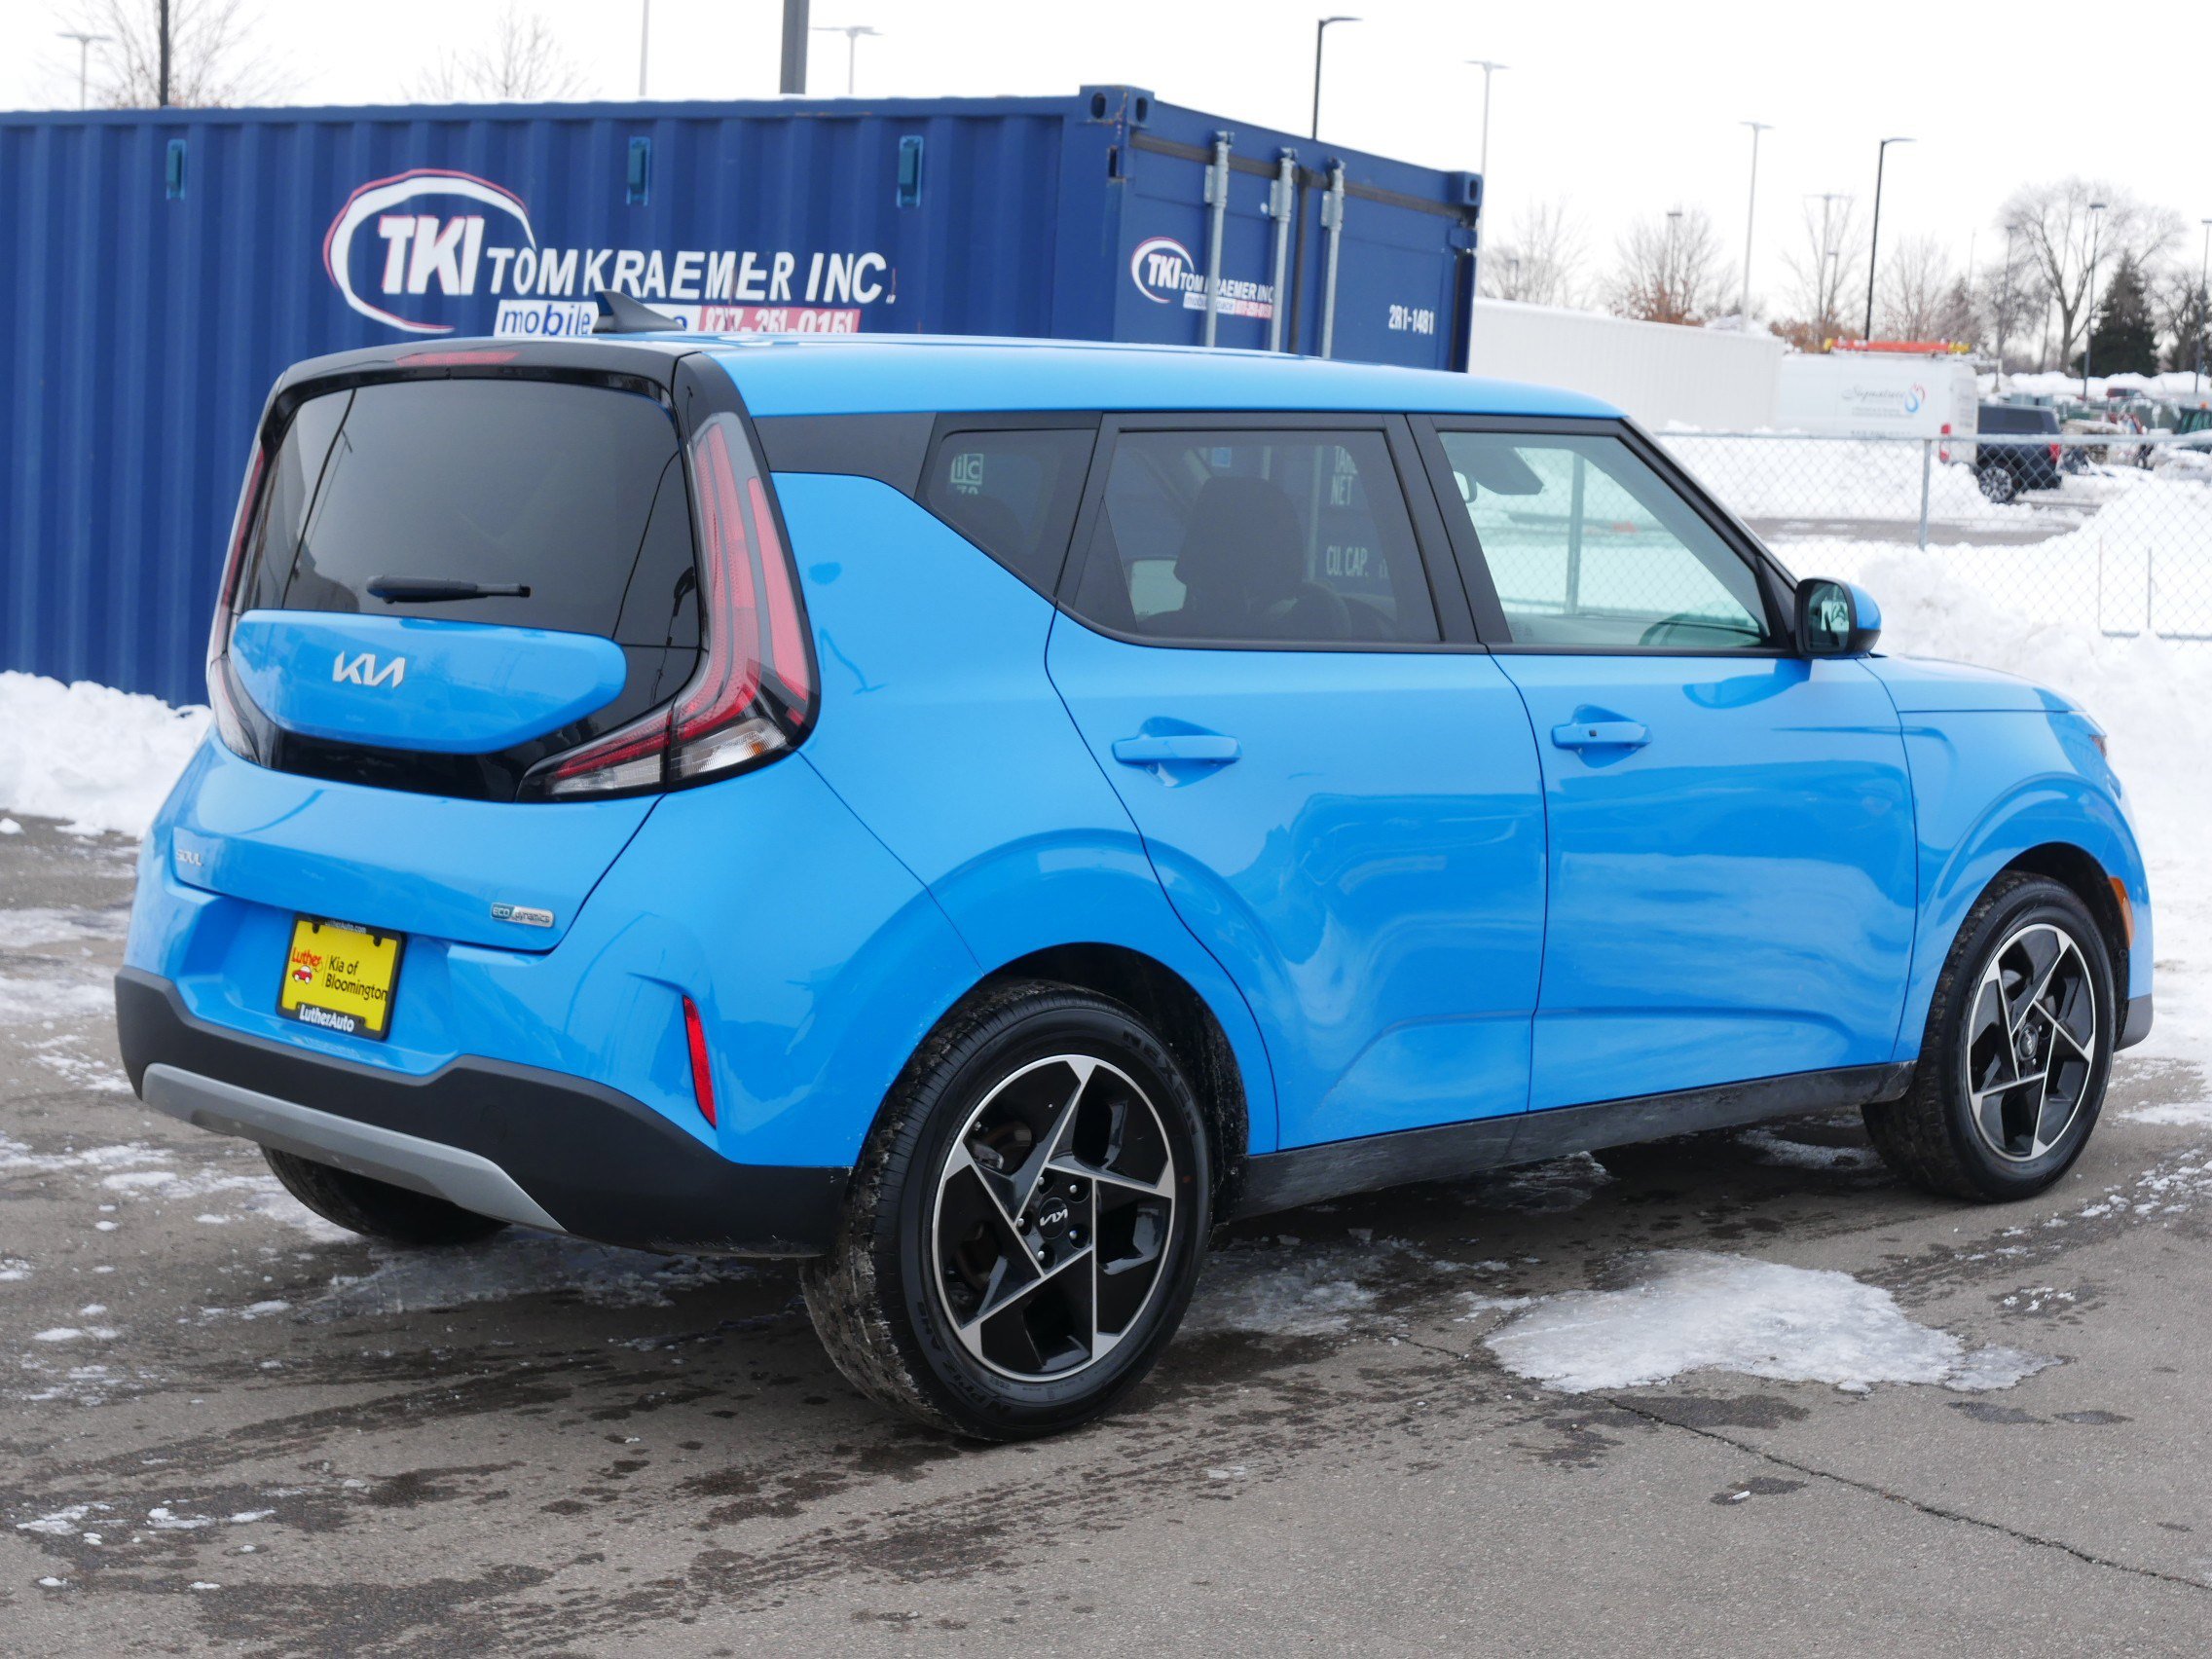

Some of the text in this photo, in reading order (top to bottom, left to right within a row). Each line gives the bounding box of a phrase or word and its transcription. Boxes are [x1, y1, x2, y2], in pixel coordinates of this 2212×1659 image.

[378, 215, 485, 295] TKI
[804, 251, 896, 304] INC.
[1148, 253, 1182, 289] TKI
[1180, 272, 1203, 292] TOM
[501, 306, 591, 336] mobile
[1330, 474, 1353, 505] NET
[332, 650, 406, 688] KIA
[493, 907, 509, 916] ECO
[291, 947, 321, 966] Luther
[329, 955, 359, 976] Kia of
[325, 974, 388, 1002] Bloomington
[299, 1004, 354, 1032] LutherAuto
[1040, 1208, 1068, 1227] KIA
